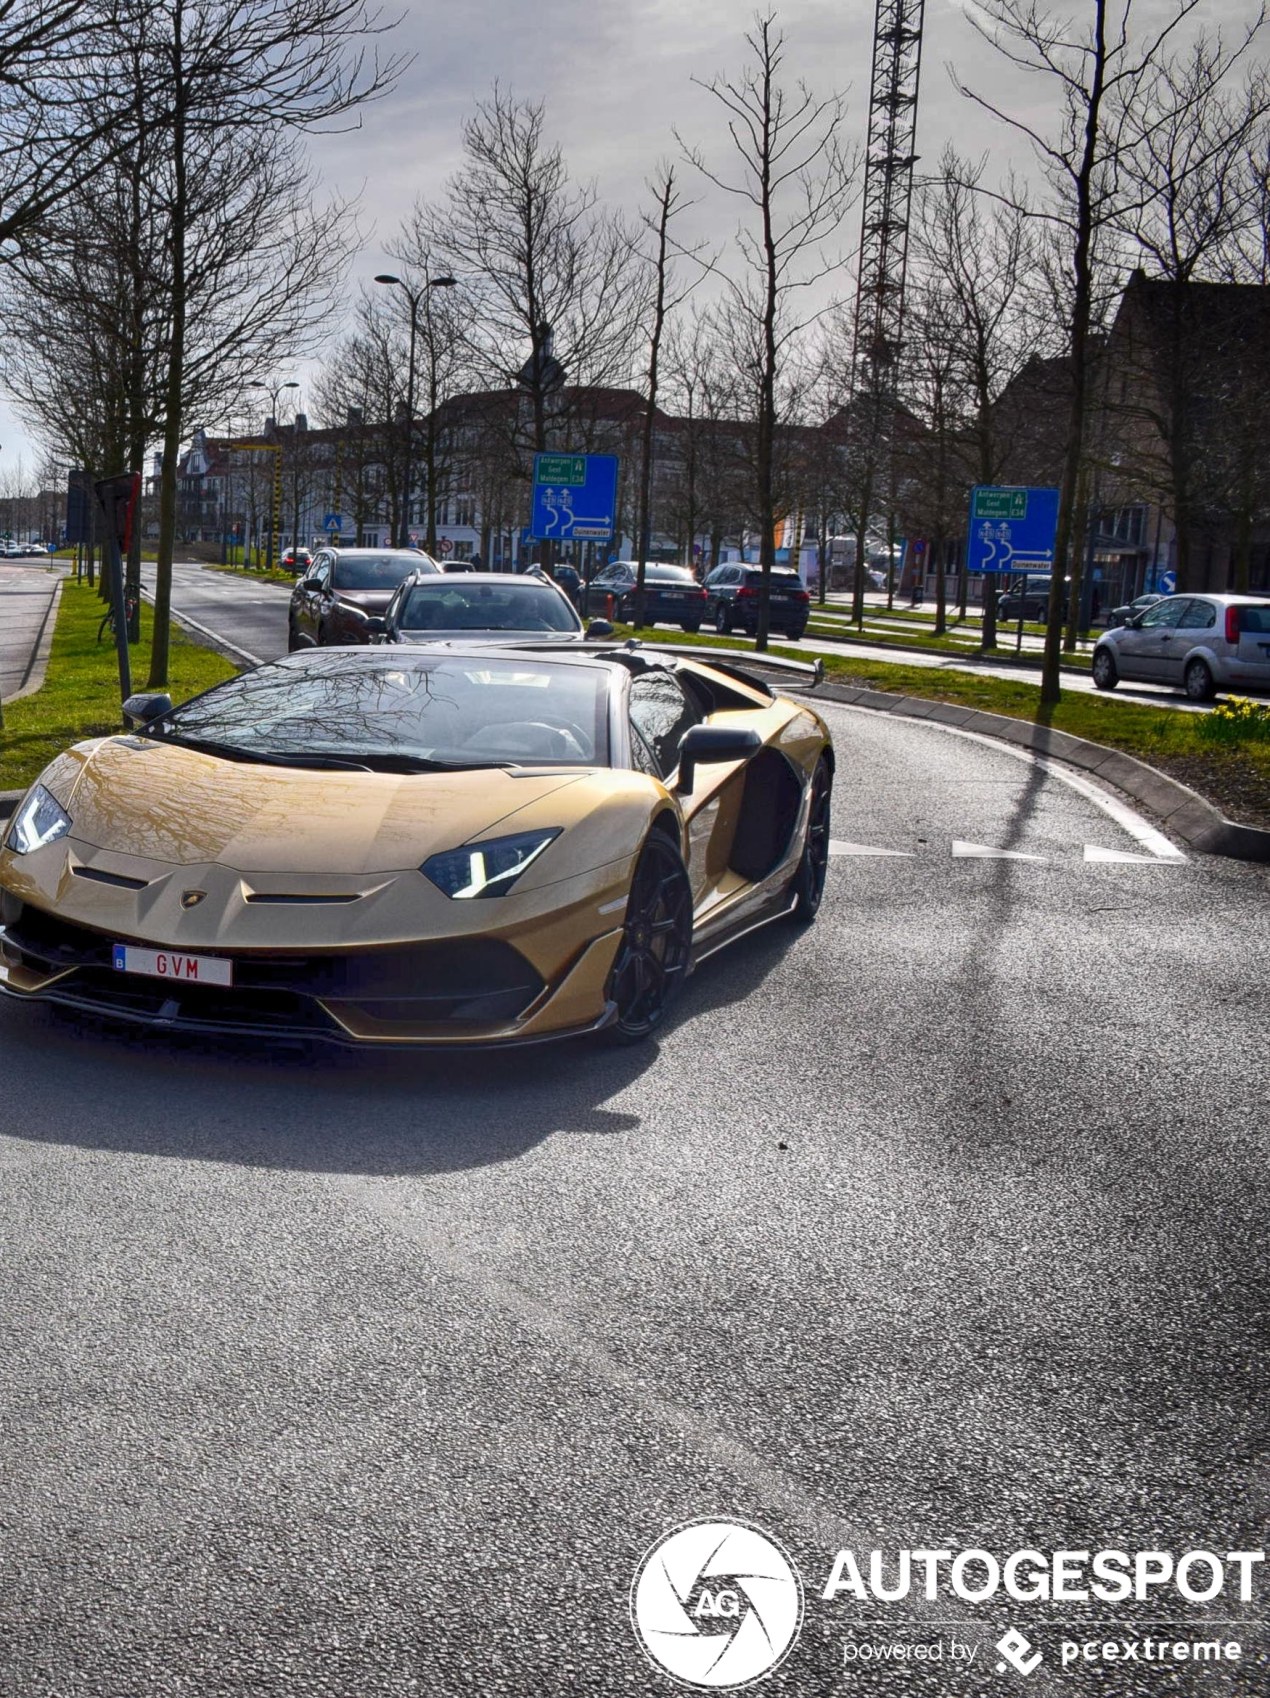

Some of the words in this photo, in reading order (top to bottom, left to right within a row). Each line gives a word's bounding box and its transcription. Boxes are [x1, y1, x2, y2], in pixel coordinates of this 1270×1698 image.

[540, 457, 571, 466] Antwerpen
[540, 475, 569, 484] Maldegem
[978, 490, 1010, 499] Antwerpen
[977, 508, 1007, 517] Maldegem
[1011, 508, 1024, 516] E34
[574, 528, 609, 536] Duinenwater
[1012, 560, 1050, 569] Duinenwater
[116, 959, 124, 968] B
[156, 954, 198, 979] GVM
